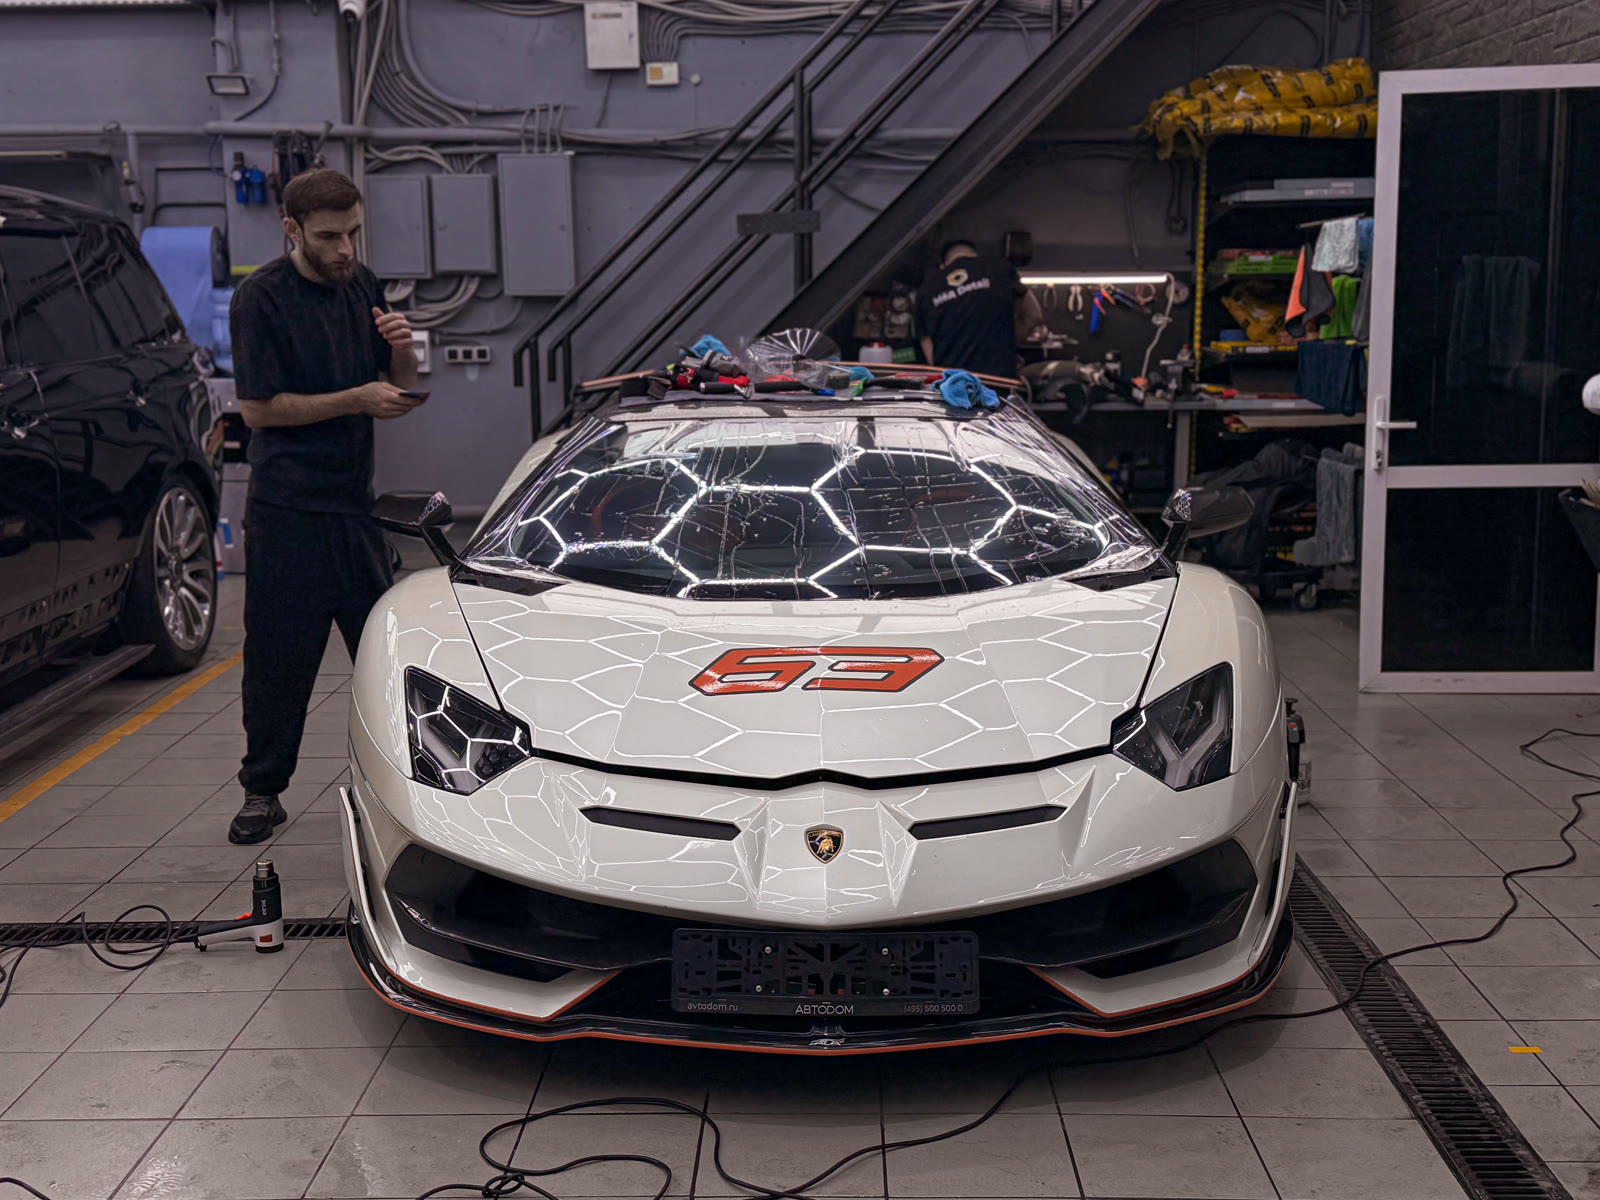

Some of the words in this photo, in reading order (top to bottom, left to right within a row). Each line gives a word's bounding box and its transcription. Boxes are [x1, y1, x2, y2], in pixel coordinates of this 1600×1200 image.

[688, 646, 946, 697] 63
[687, 1002, 739, 1012] avtodom.ru
[904, 1004, 923, 1014] (495)
[924, 1004, 940, 1013] 500
[941, 1004, 956, 1012] 500
[957, 1004, 963, 1012] 0
